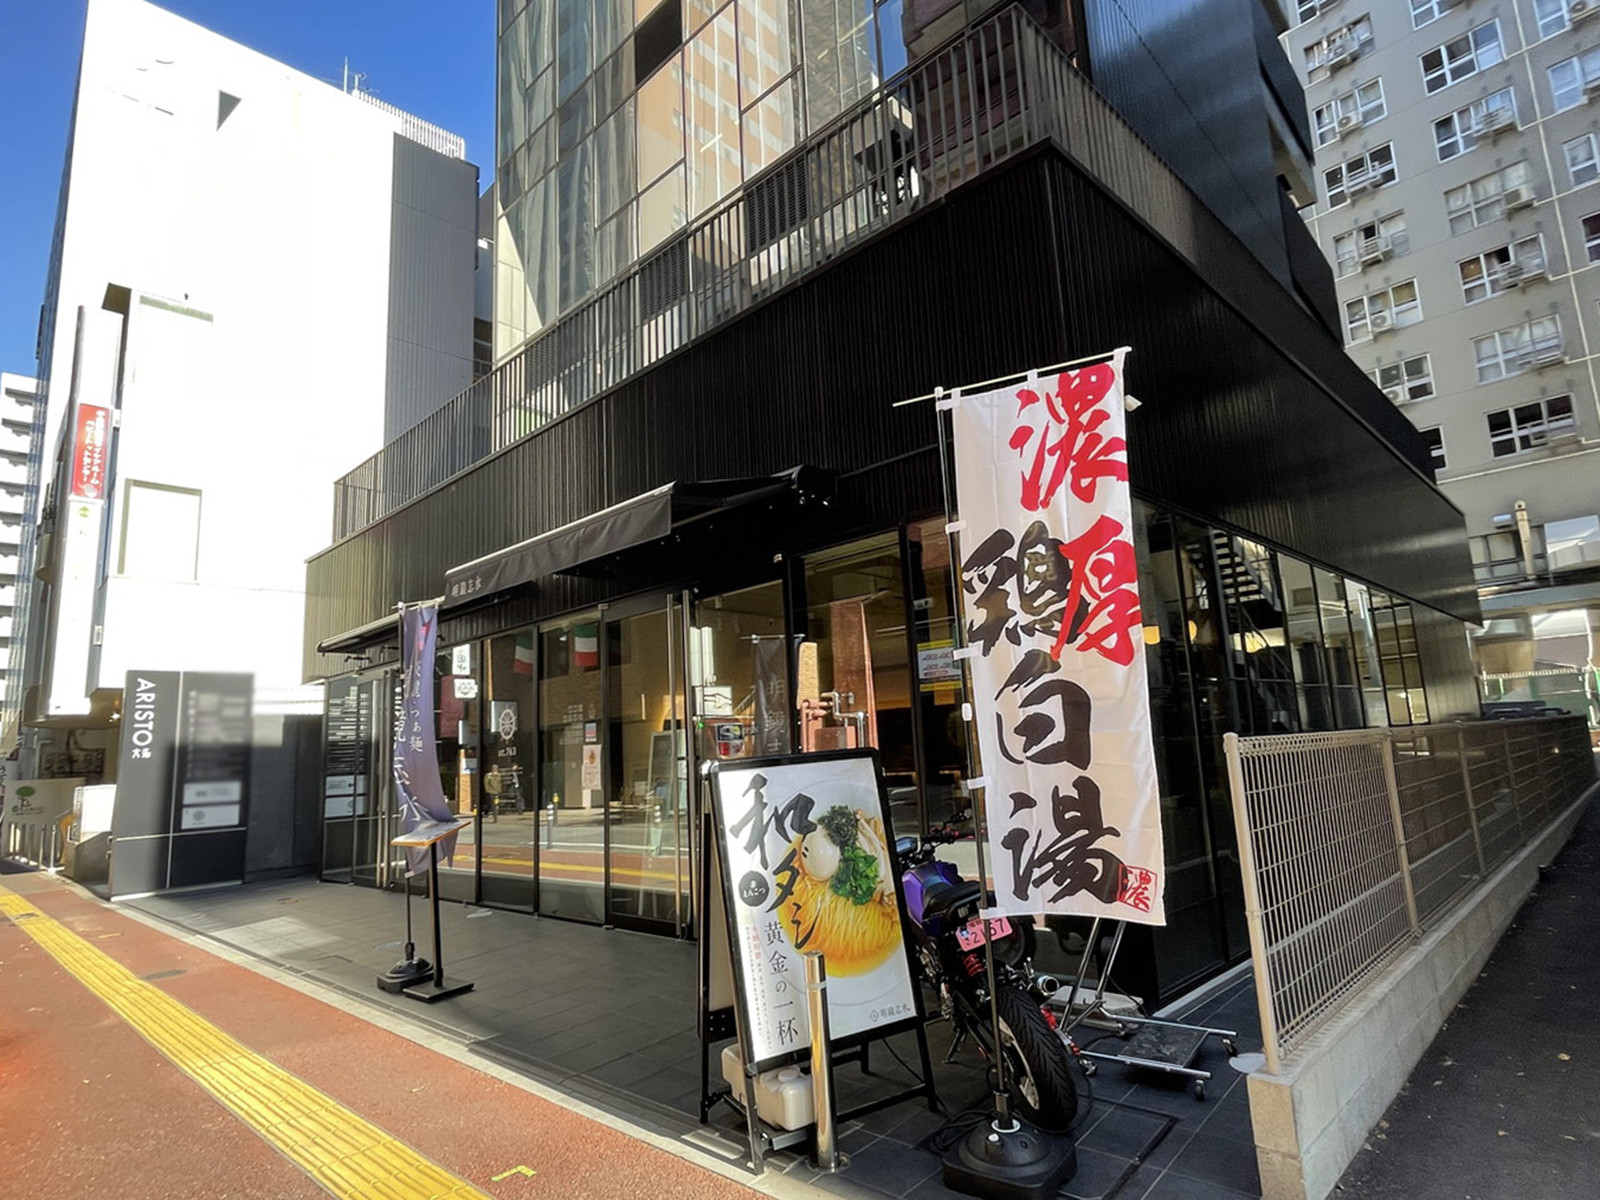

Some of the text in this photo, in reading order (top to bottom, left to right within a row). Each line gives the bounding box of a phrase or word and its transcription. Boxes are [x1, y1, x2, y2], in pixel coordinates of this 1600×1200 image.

[1010, 362, 1142, 667] 濃厚
[132, 678, 156, 747] ARISTO
[961, 520, 1125, 905] 鶏白湯
[729, 772, 823, 950] 和ダシ
[764, 921, 799, 1047] 黄金の一杯
